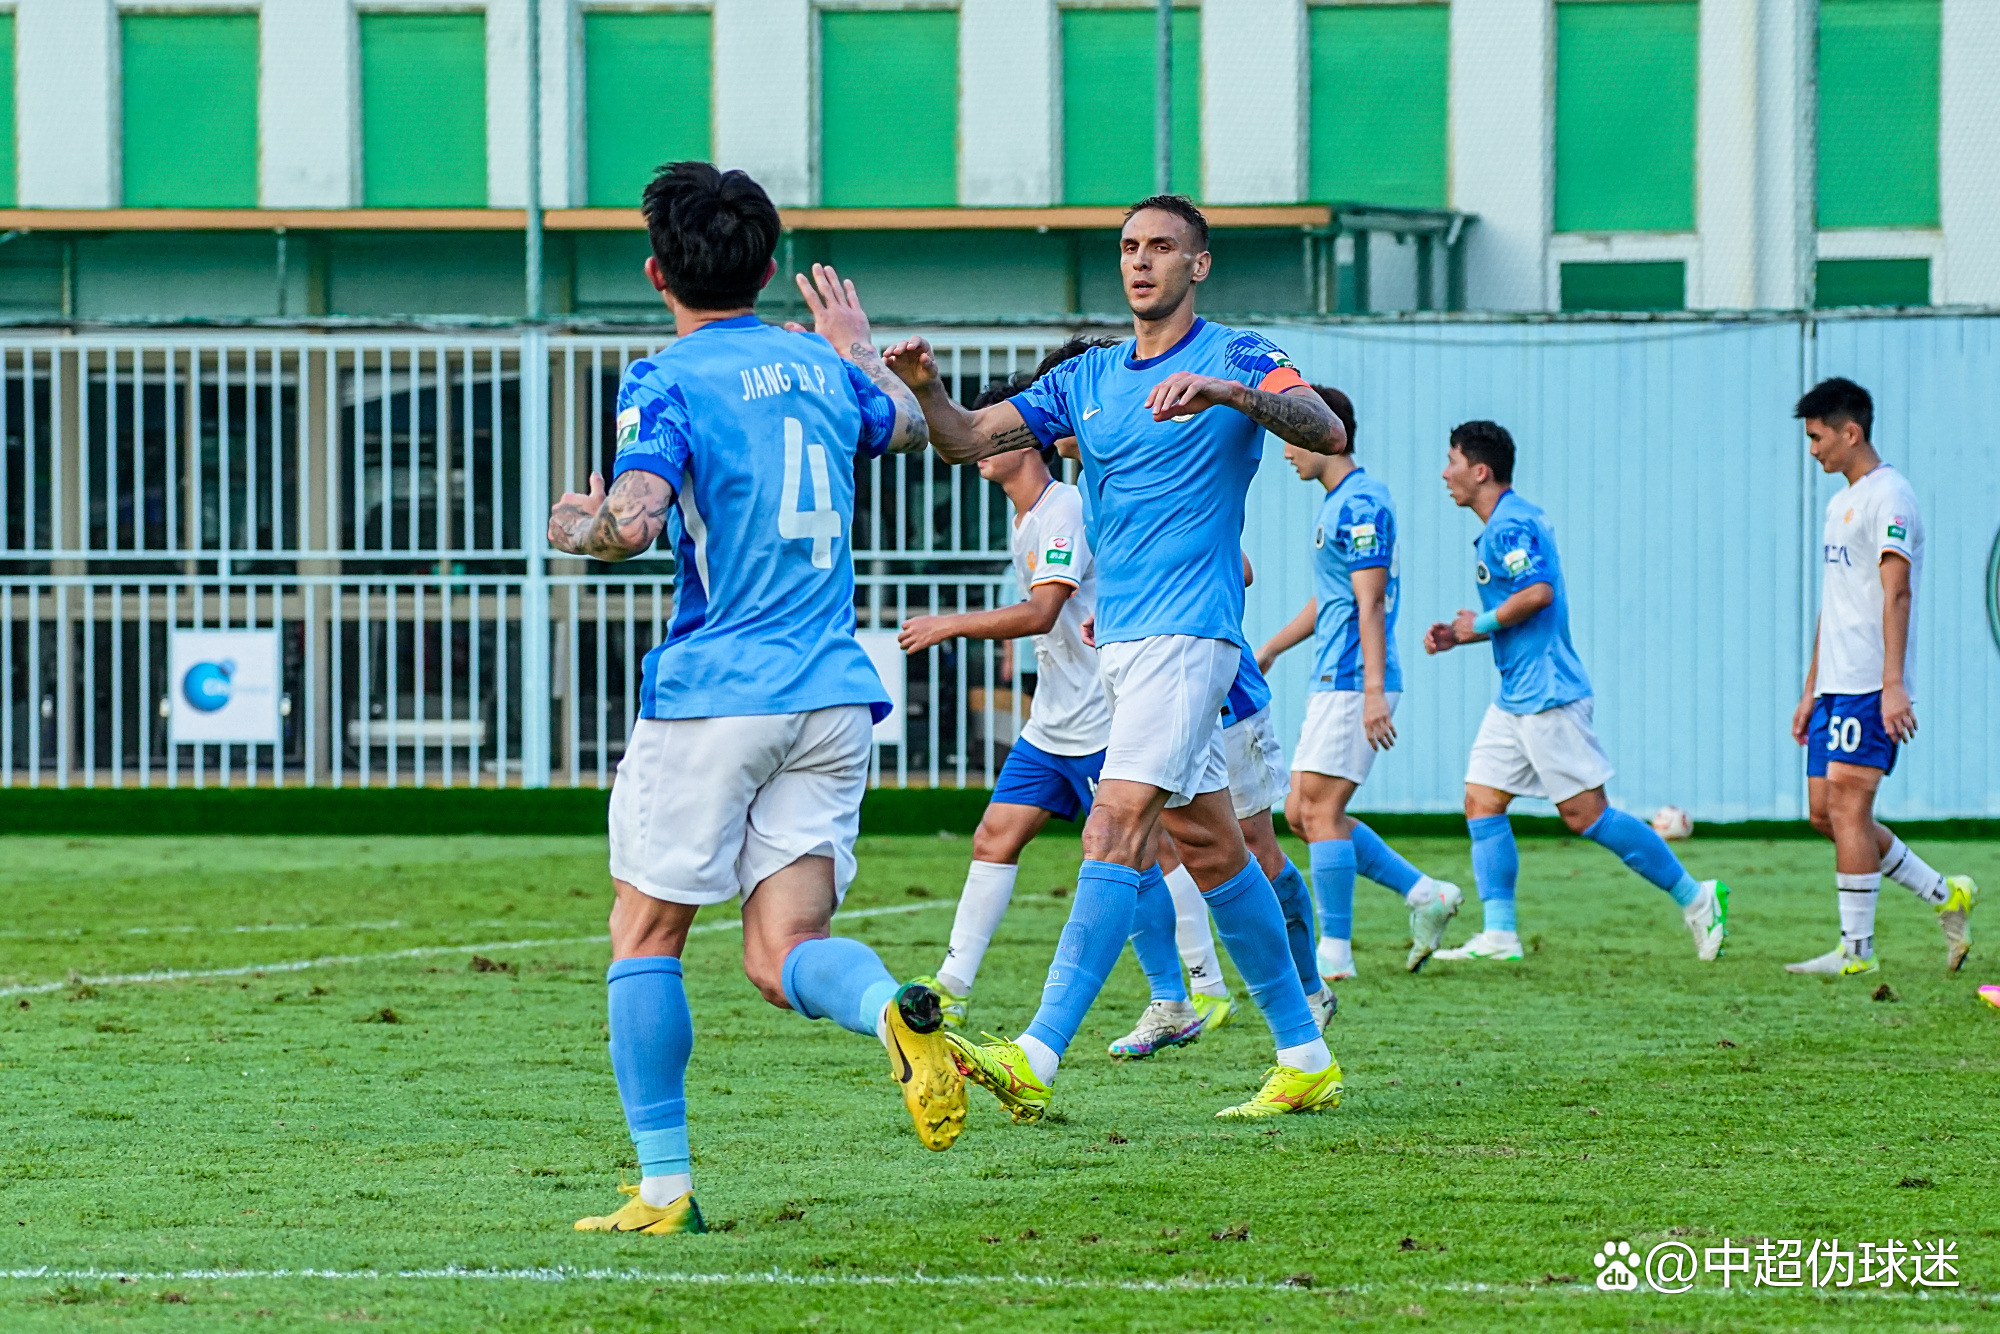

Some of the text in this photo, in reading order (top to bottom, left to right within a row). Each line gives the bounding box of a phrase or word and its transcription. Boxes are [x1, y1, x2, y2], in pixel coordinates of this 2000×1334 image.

[740, 362, 792, 401] JIANG
[778, 416, 841, 569] 4
[1826, 714, 1862, 753] 50
